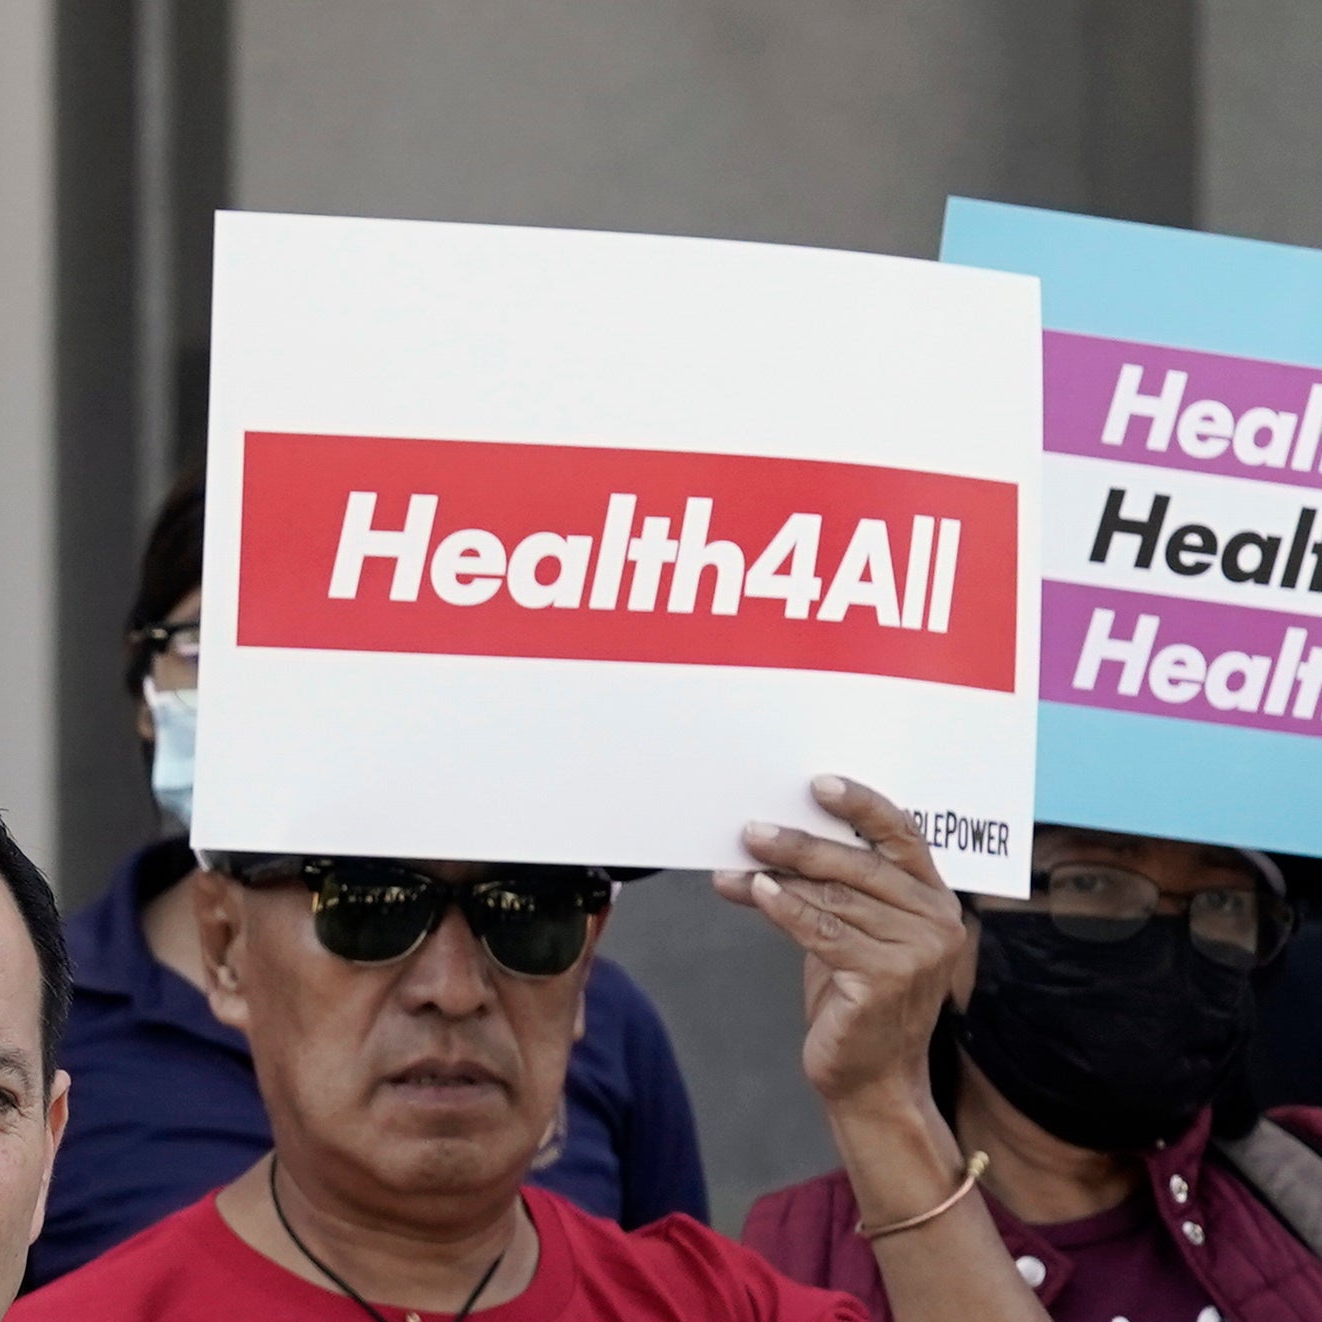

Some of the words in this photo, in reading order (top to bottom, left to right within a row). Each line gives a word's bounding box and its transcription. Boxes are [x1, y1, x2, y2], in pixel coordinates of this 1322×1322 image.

[1101, 363, 1322, 473] Heal
[327, 490, 961, 633] Health4All
[1072, 607, 1322, 720] Healt
